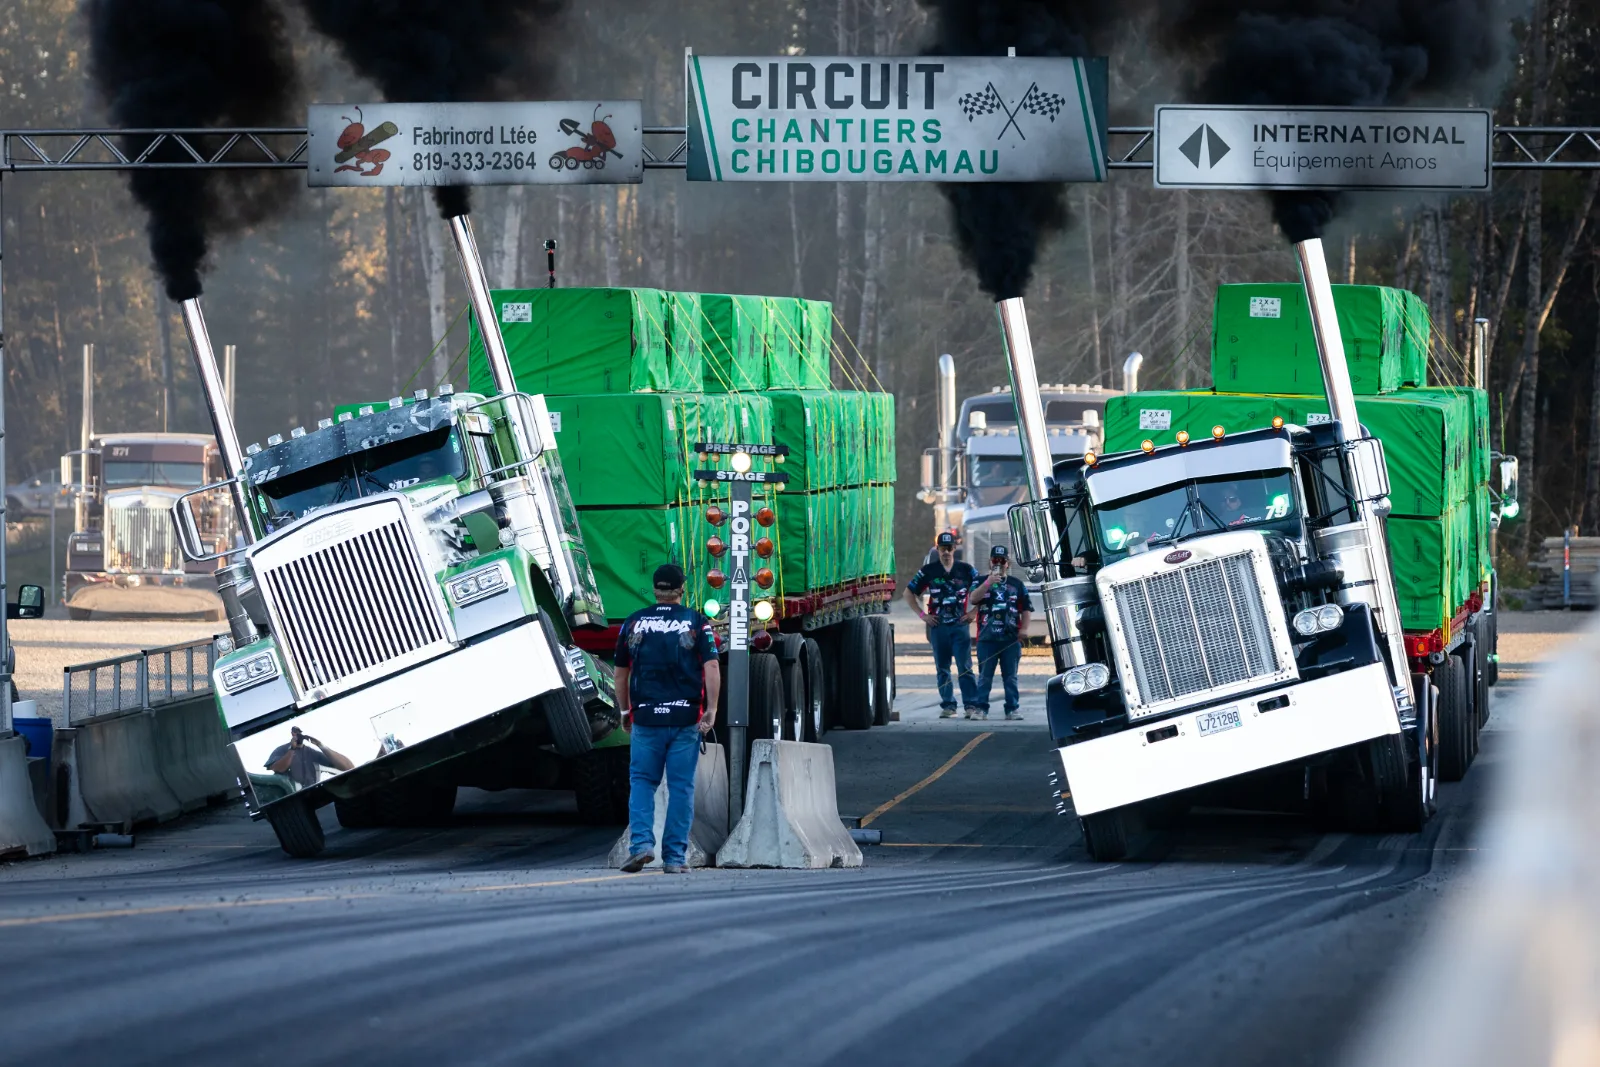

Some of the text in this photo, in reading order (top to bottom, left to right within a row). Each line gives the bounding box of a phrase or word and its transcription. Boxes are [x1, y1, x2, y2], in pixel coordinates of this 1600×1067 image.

[732, 62, 945, 110] CIRCUIT
[413, 125, 537, 146] Fabrinord Ltée
[731, 118, 943, 143] CHANTIERS
[1253, 124, 1465, 145] INTERNATIONAL
[413, 151, 537, 171] 819-333-2364
[731, 149, 999, 174] CHIBOUGAMAU
[1253, 146, 1437, 173] Équipement Amos
[705, 443, 776, 454] PRE-STAGE
[716, 471, 766, 481] STAGE
